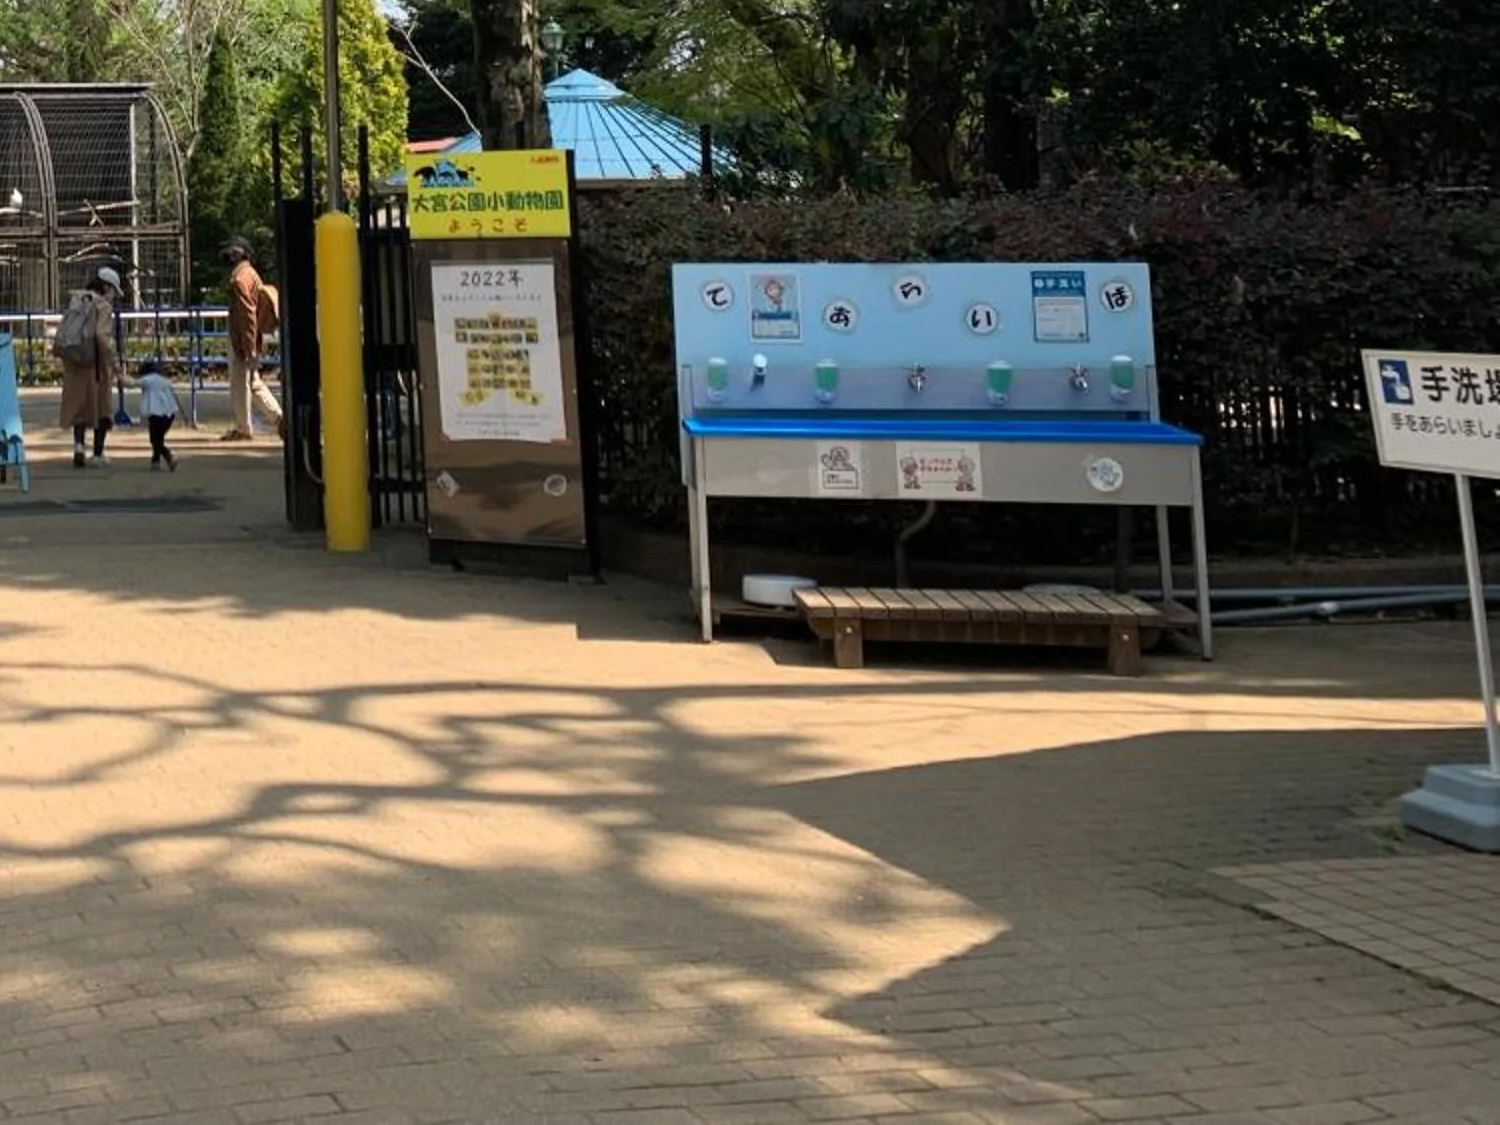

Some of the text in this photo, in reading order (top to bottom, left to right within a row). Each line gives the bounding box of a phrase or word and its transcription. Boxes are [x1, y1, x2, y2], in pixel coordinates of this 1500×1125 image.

[411, 190, 564, 213] 大宮公園小動物園
[448, 218, 528, 233] ようこそ
[460, 270, 523, 290] 2022年
[707, 286, 728, 307] て
[830, 306, 851, 327] あ
[900, 282, 922, 299] ら
[971, 309, 992, 328] い
